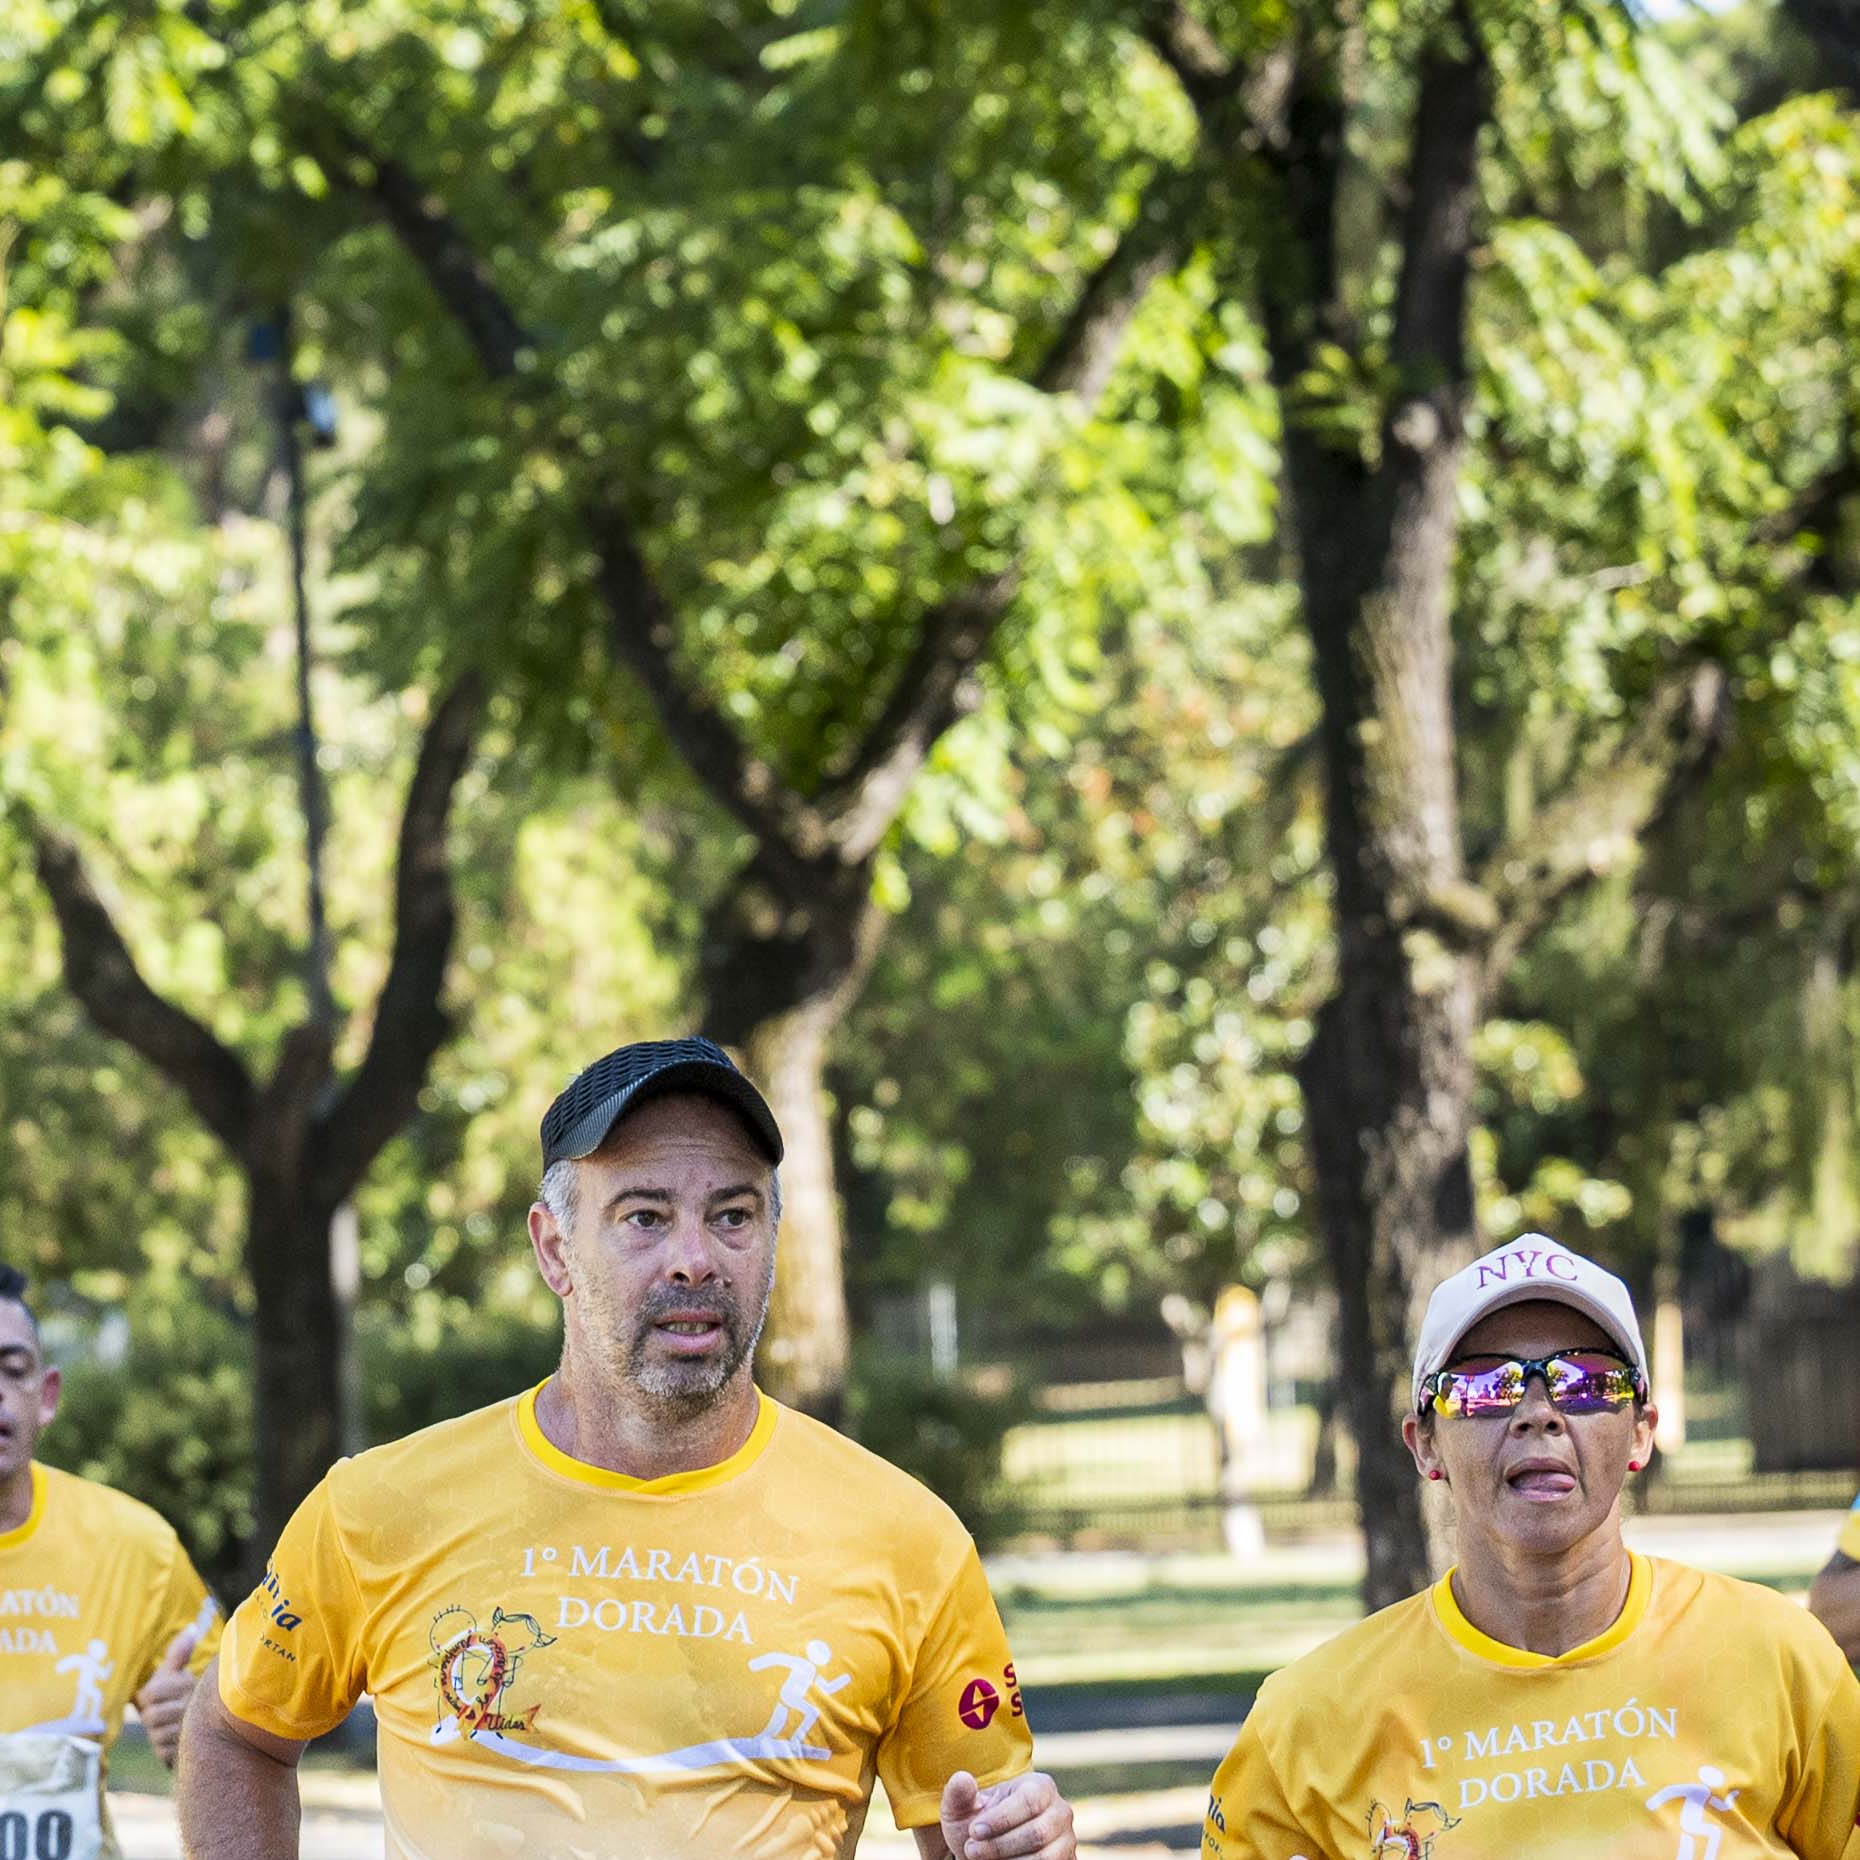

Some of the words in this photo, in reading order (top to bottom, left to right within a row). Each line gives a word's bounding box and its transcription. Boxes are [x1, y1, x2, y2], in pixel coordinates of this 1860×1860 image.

[1477, 1250, 1578, 1289] NYC
[568, 1546, 799, 1605] MARATÓN
[557, 1596, 754, 1644] DORADA
[1464, 1697, 1678, 1761] MARATÓN
[1458, 1755, 1646, 1809] DORADA
